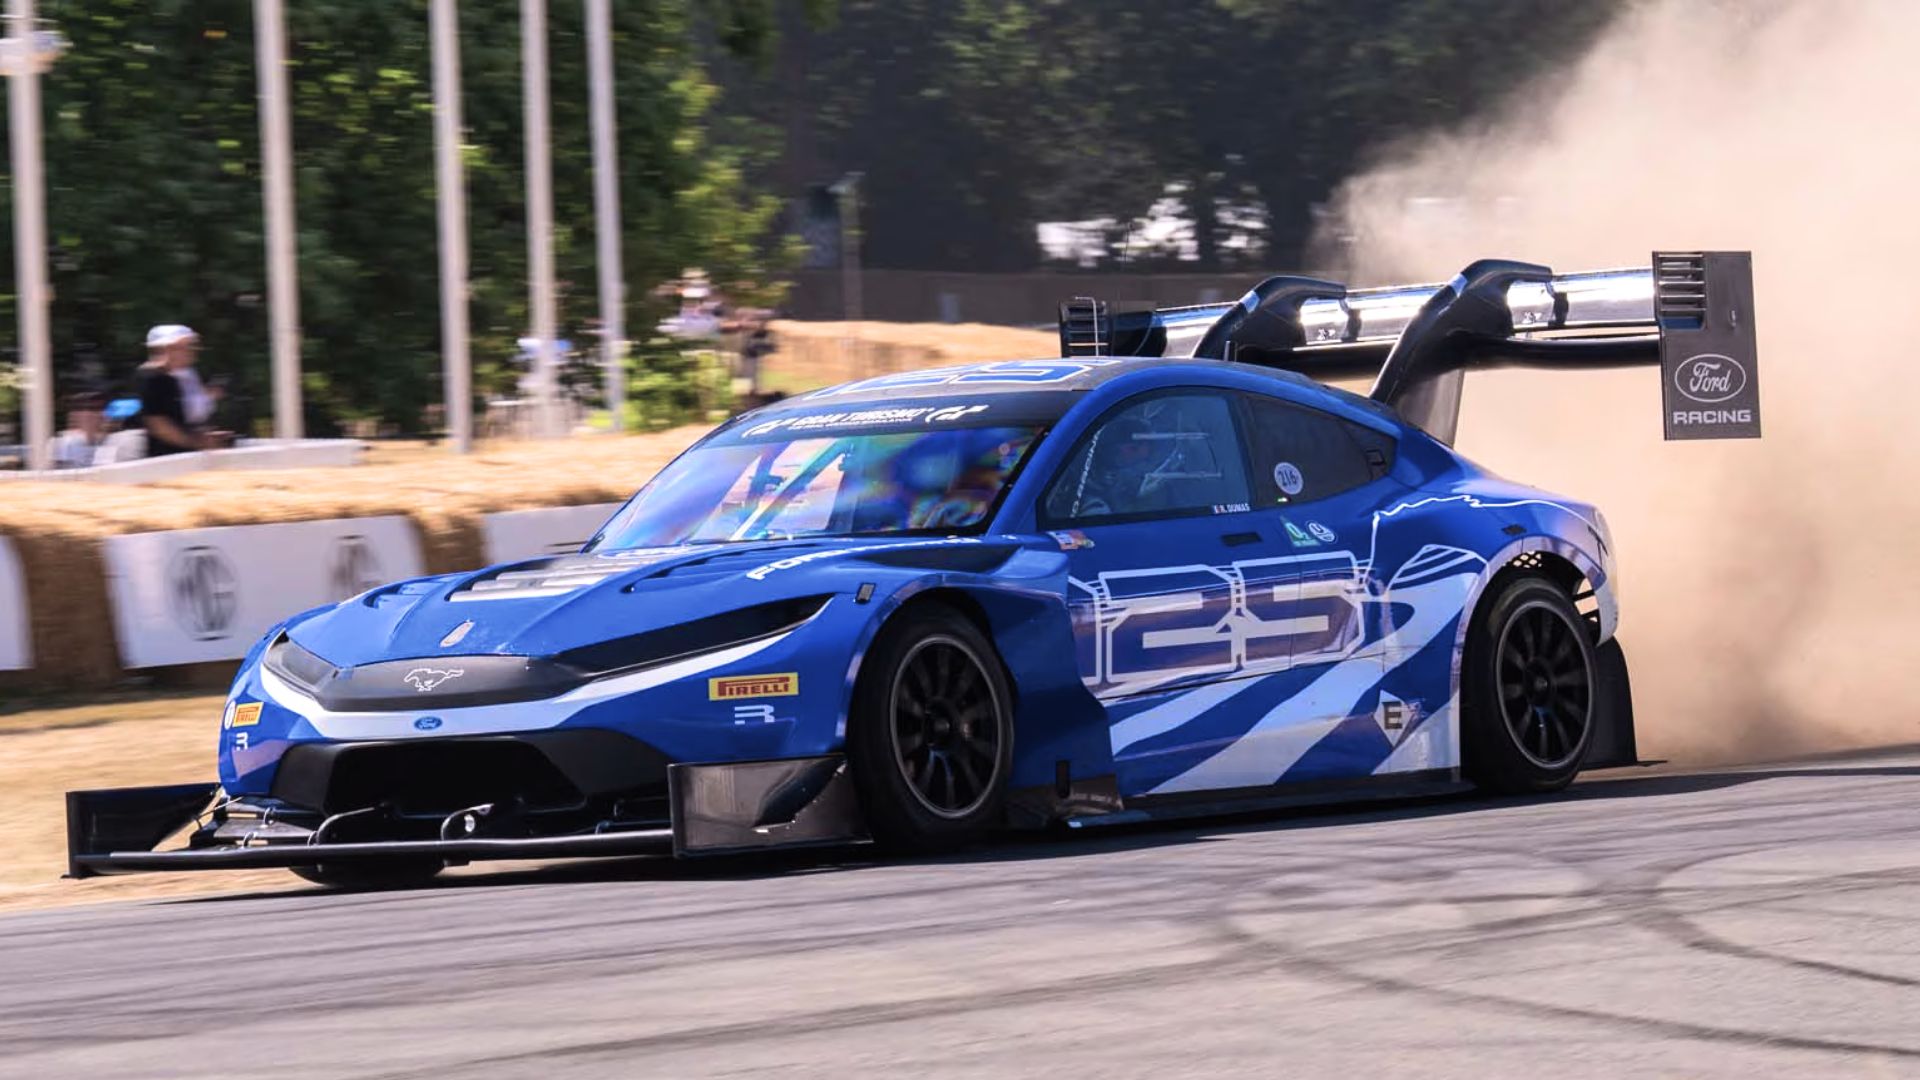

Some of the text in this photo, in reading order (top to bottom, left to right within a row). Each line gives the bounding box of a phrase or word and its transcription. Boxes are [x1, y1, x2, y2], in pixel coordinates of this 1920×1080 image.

[1689, 361, 1732, 393] Ford
[1673, 409, 1751, 424] RACING
[717, 676, 790, 697] PIRELLI
[1382, 701, 1403, 730] E
